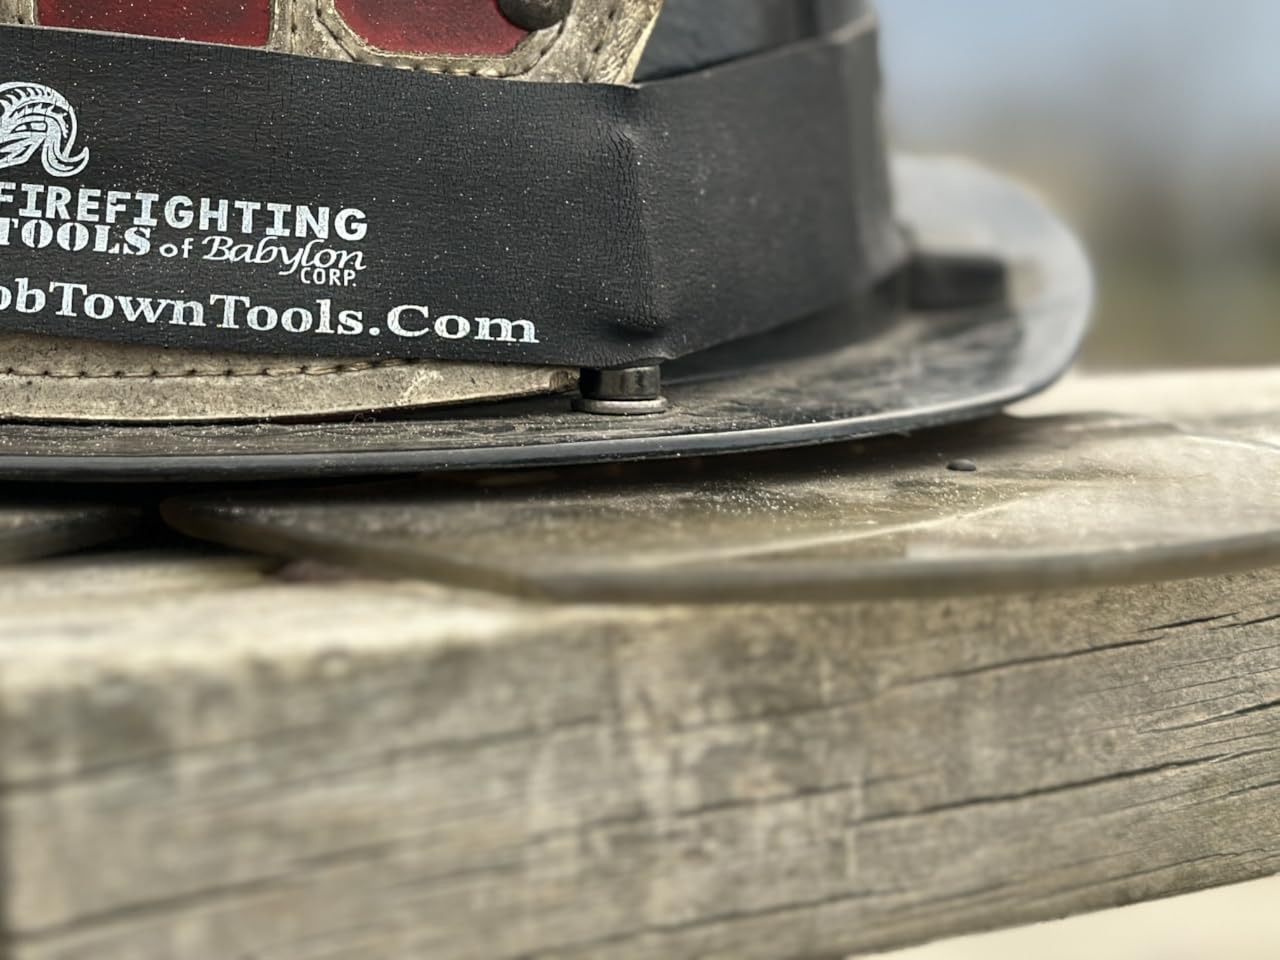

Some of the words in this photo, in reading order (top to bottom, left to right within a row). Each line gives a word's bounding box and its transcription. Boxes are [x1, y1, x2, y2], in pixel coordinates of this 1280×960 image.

[159, 237, 194, 259] of
[201, 234, 367, 276] Babylon
[300, 266, 357, 288] CORP.
